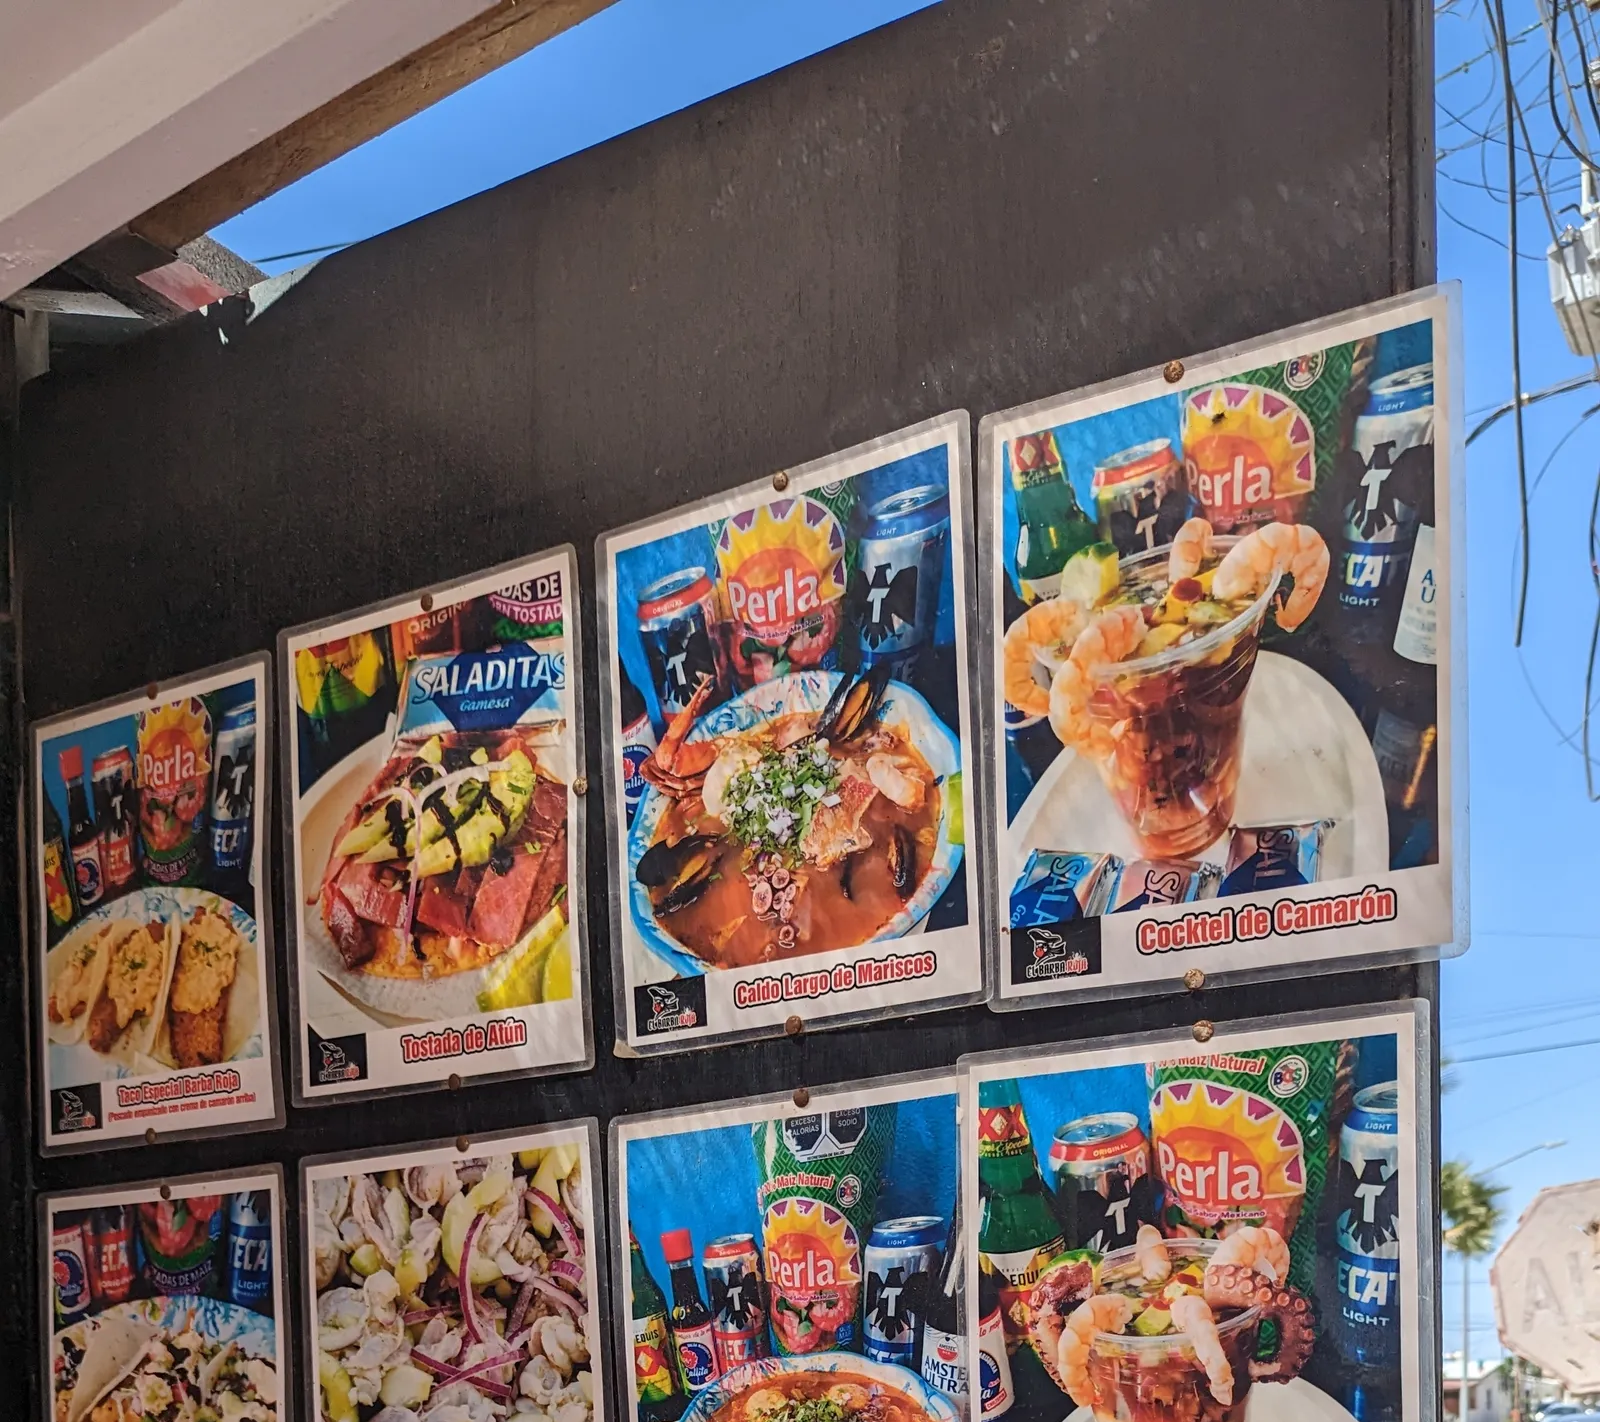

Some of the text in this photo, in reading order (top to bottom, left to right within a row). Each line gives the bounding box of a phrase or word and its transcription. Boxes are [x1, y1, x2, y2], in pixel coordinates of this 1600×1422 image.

[1377, 401, 1406, 412] LIGHT
[1185, 455, 1272, 507] Perla
[876, 527, 897, 537] LIGHT
[537, 575, 560, 600] DE
[727, 568, 820, 623] Perla
[1339, 593, 1381, 607] LIGHT
[408, 601, 467, 634] ORIGIN
[412, 652, 565, 705] SALADITAS
[460, 698, 511, 712] Gamesa
[143, 744, 196, 788] Perla
[217, 859, 241, 869] LIGHT
[1140, 887, 1393, 951] Cocktel de Camarón
[737, 953, 934, 1006] Caldo Largo de Mariscos
[1026, 964, 1037, 979] EL
[1038, 961, 1066, 977] BARBA
[403, 1020, 524, 1061] Tostada de Atún
[1210, 1055, 1266, 1075] Natural
[119, 1071, 239, 1105] Taco Especial Barba Roja
[791, 1115, 816, 1127] EXCESO
[838, 1117, 857, 1127] SODIO
[1365, 1122, 1393, 1131] LIGHT
[1093, 1143, 1128, 1157] ORIGINAL
[798, 1172, 835, 1189] Natural
[1158, 1140, 1261, 1201] Perla
[1220, 1210, 1266, 1219] Mexicano
[886, 1239, 907, 1247] LIGHT
[768, 1249, 836, 1289] Perla
[238, 1279, 268, 1290] LIGHT
[1343, 1307, 1390, 1327] LIGHT
[924, 1369, 970, 1395] ULTRA
